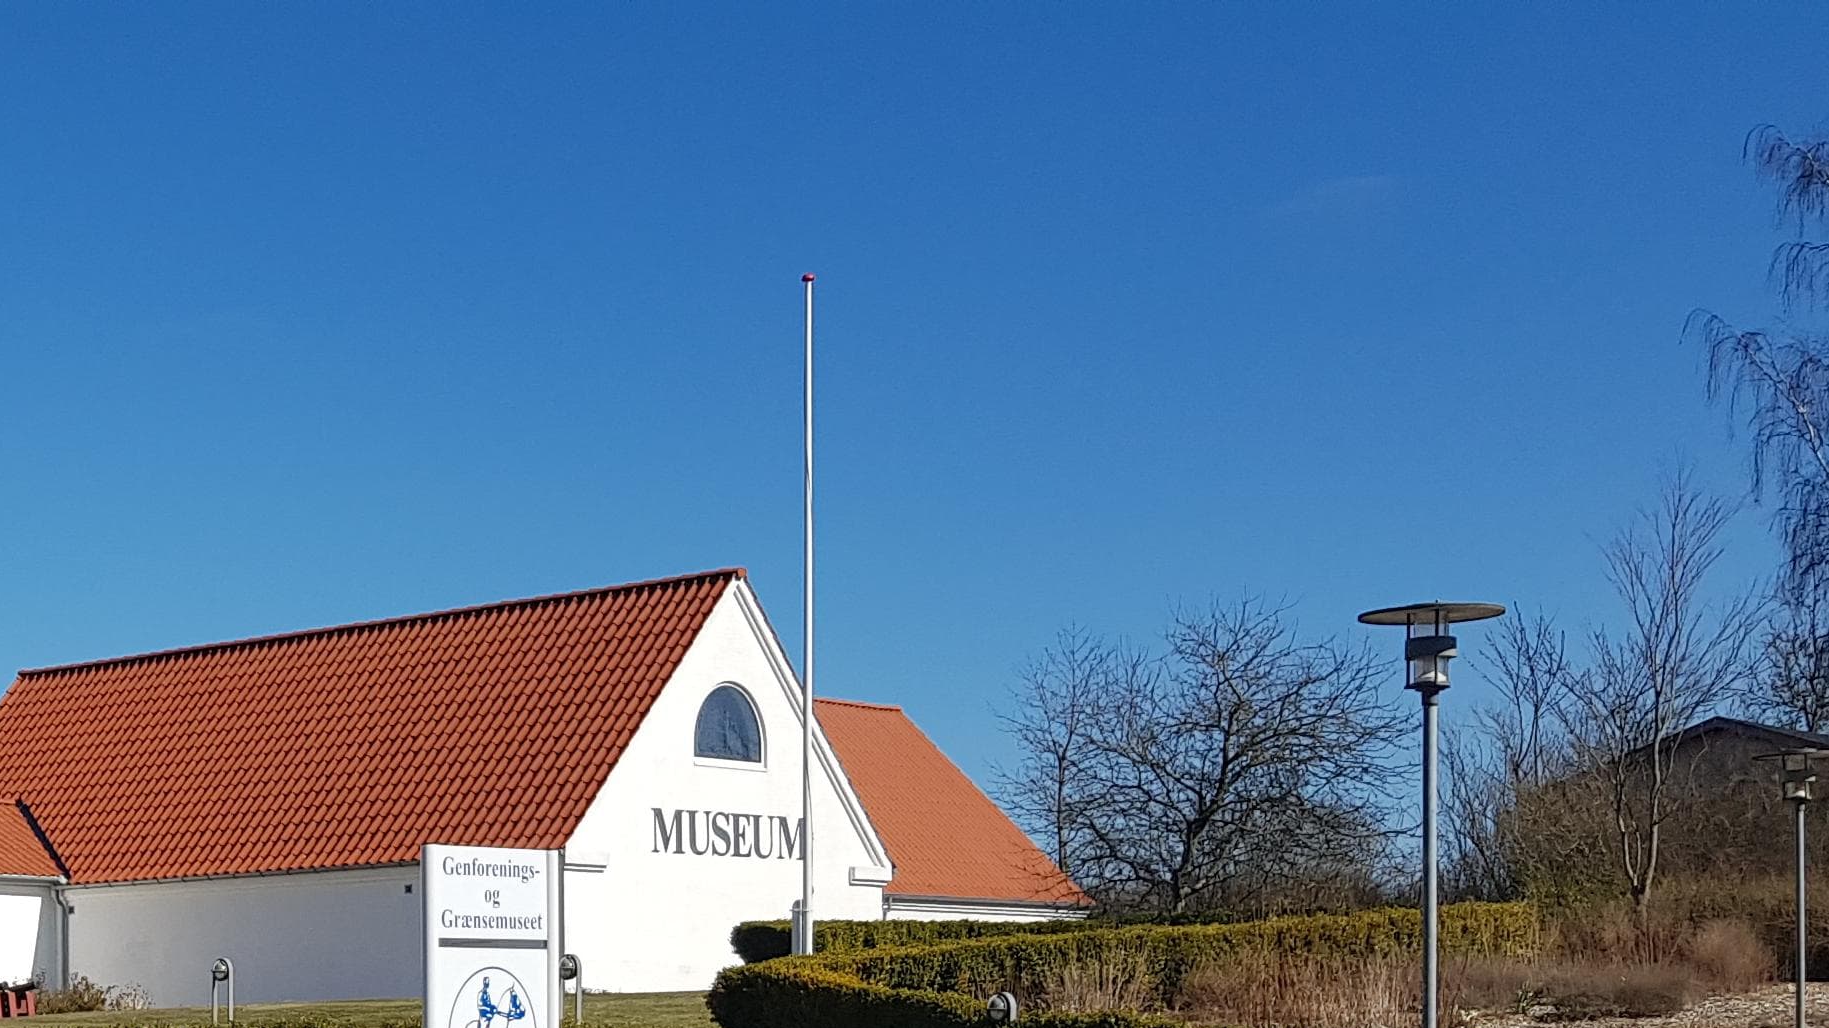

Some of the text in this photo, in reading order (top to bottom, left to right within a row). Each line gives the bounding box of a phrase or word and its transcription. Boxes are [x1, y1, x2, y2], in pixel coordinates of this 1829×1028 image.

[651, 807, 804, 861] MUSEUM
[442, 856, 541, 883] Genforenings-
[484, 889, 501, 908] og
[441, 909, 543, 930] Grænsemuseet
